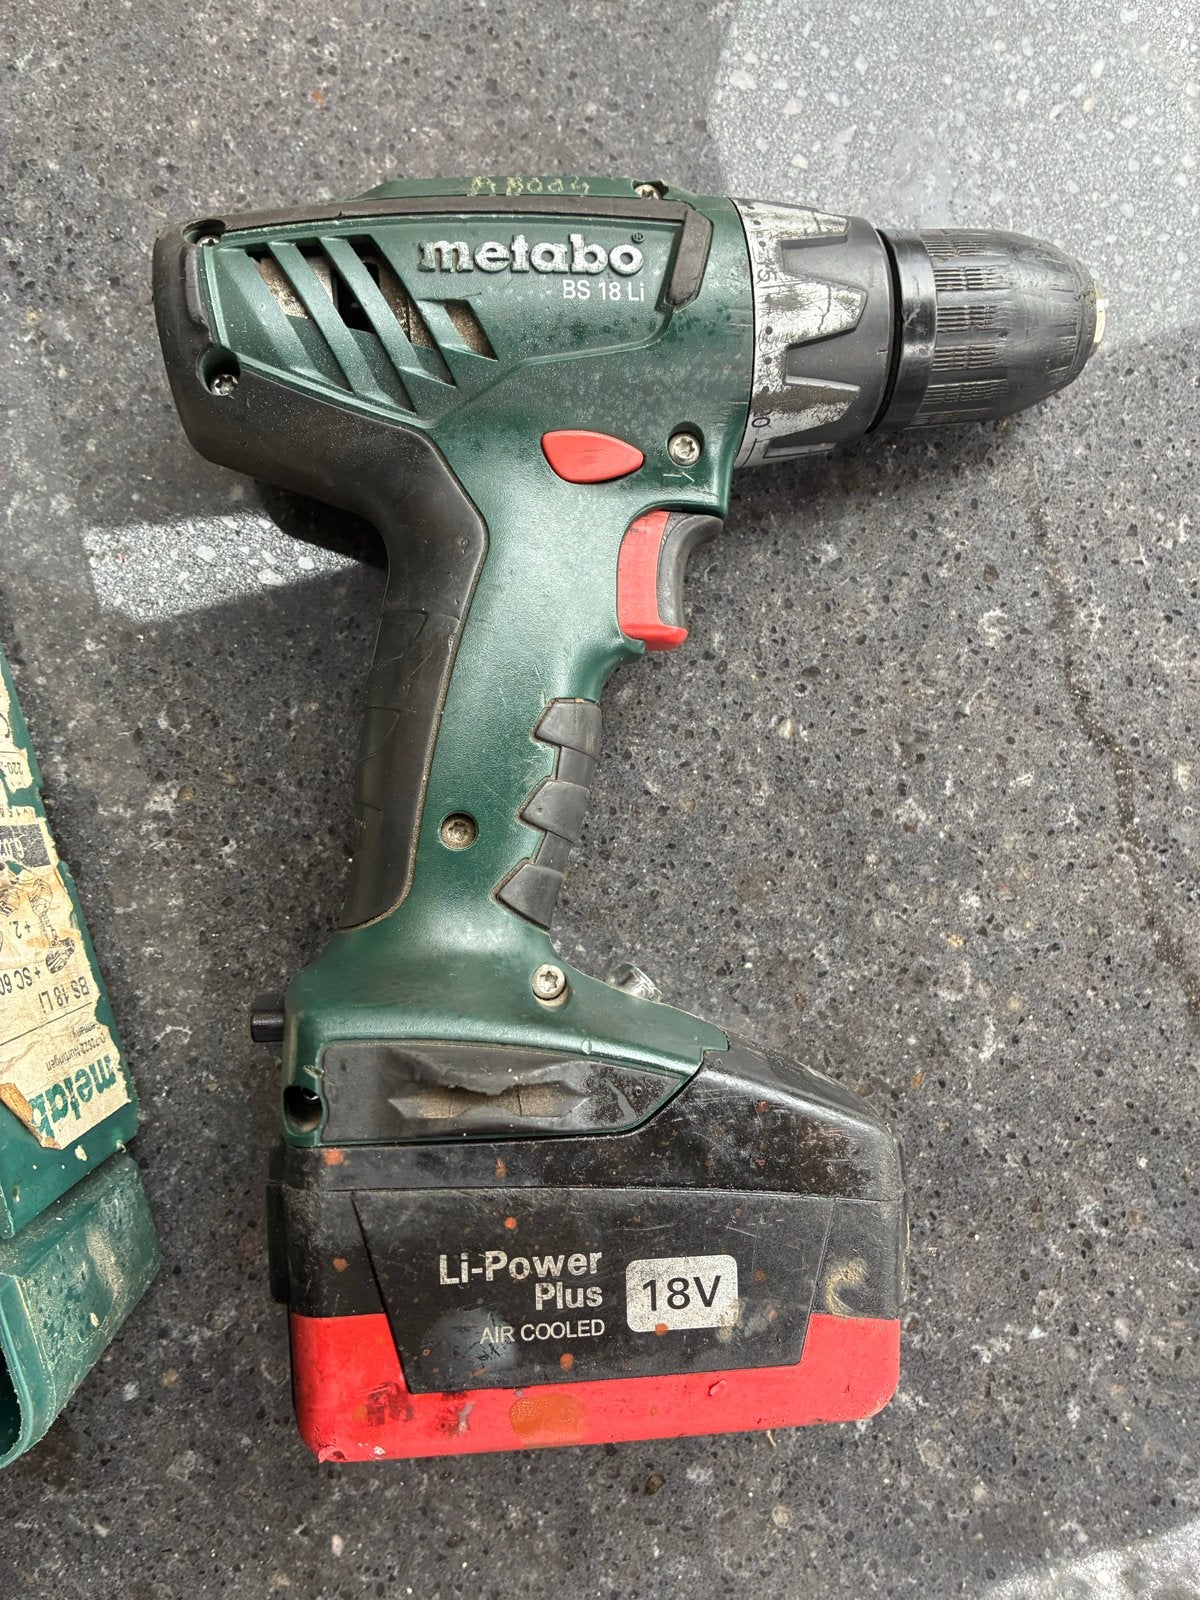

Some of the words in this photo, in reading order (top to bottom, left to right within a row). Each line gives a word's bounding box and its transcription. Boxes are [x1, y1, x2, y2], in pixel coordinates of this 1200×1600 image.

[418, 233, 644, 276] metabo
[562, 279, 591, 301] BS
[598, 280, 621, 301] 18
[628, 281, 645, 302] Li
[14, 966, 33, 991] SC
[70, 976, 90, 1000] BS
[37, 990, 54, 1014] Li
[53, 984, 70, 1008] 18
[438, 1249, 603, 1285] Li-Power
[534, 1282, 604, 1311] Plus
[642, 1274, 722, 1312] 18V
[480, 1326, 515, 1345] AIR
[520, 1319, 605, 1342] COOLED
